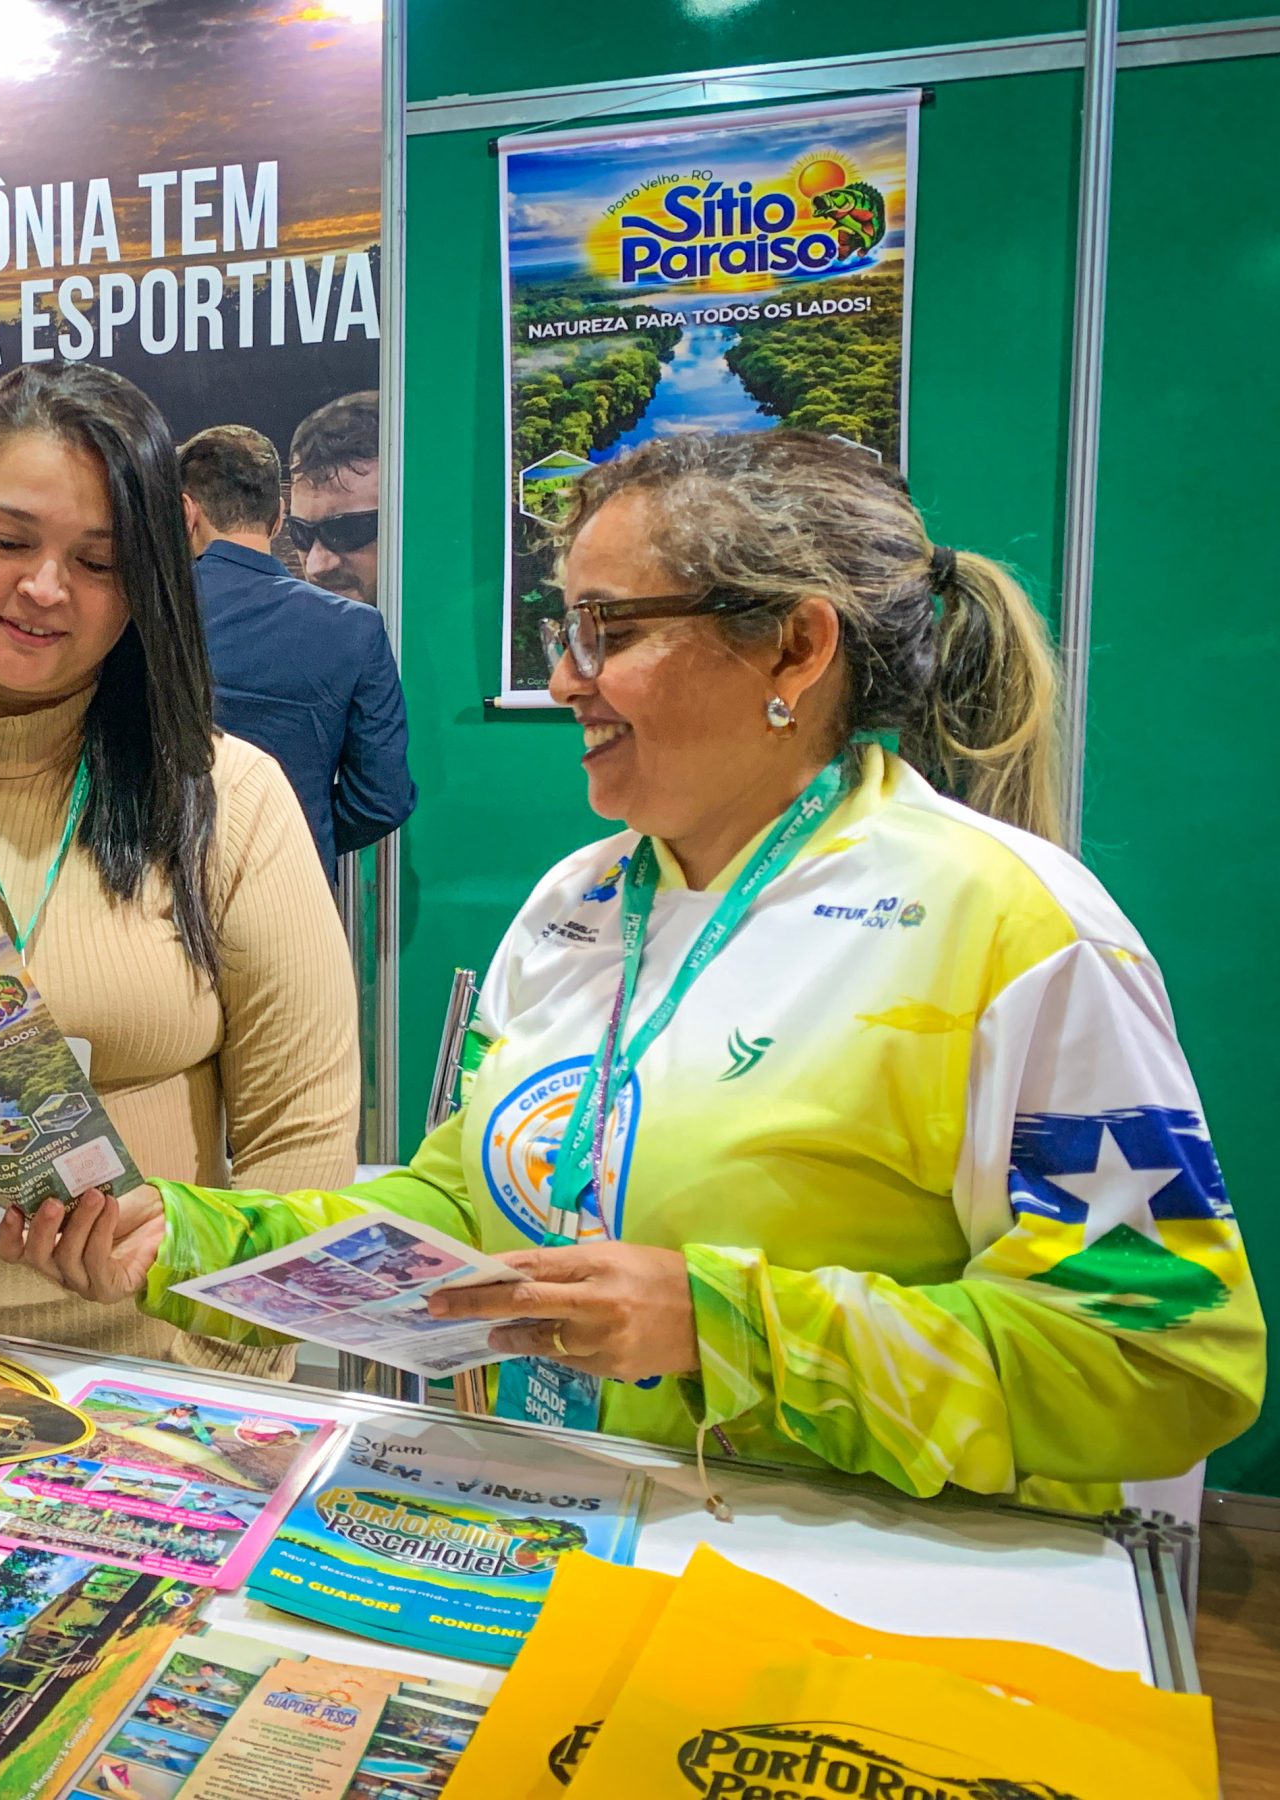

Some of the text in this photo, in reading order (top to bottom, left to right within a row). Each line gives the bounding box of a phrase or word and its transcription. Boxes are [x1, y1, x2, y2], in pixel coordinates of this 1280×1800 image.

[138, 161, 278, 258] TEM
[607, 169, 713, 216] Porto Velho RO
[621, 181, 796, 242] Sítio
[621, 232, 839, 283] Paraiso
[21, 253, 380, 364] ESPORTIVA
[528, 296, 871, 339] NATUREZA PARA TODOS OS LADOS!
[768, 815, 804, 863] ALBATROZ
[813, 904, 867, 919] SETUR
[624, 913, 642, 958] PESCA
[687, 920, 727, 969] PESCA
[18, 1134, 70, 1165] CORRERIA
[25, 1143, 72, 1171] NATUREZA!
[502, 1184, 519, 1206] DE
[536, 1364, 560, 1387] PESCA
[525, 1396, 565, 1427] SHOW
[527, 1376, 567, 1417] TRADE
[348, 1454, 601, 1512] BEM VINDOS
[270, 1567, 401, 1614] RIO GUAPORÉ
[279, 1549, 306, 1564] Aqui
[320, 1564, 373, 1585] descanso
[387, 1584, 449, 1603] garantido
[475, 1604, 511, 1615] pesca
[263, 1692, 358, 1728] GUAPORÉ PESCA
[260, 1726, 342, 1751] PESCA ESPORTIVA
[271, 1736, 322, 1753] AMAZÔNIA
[29, 1756, 65, 1792] Mequens
[58, 1749, 69, 1758] &
[223, 1752, 285, 1773] Apartamentos
[228, 1773, 266, 1788] chuveiro
[246, 1751, 314, 1772] HOSPEDAGEM
[209, 1775, 248, 1790] conforto
[293, 1776, 333, 1792] banheiro
